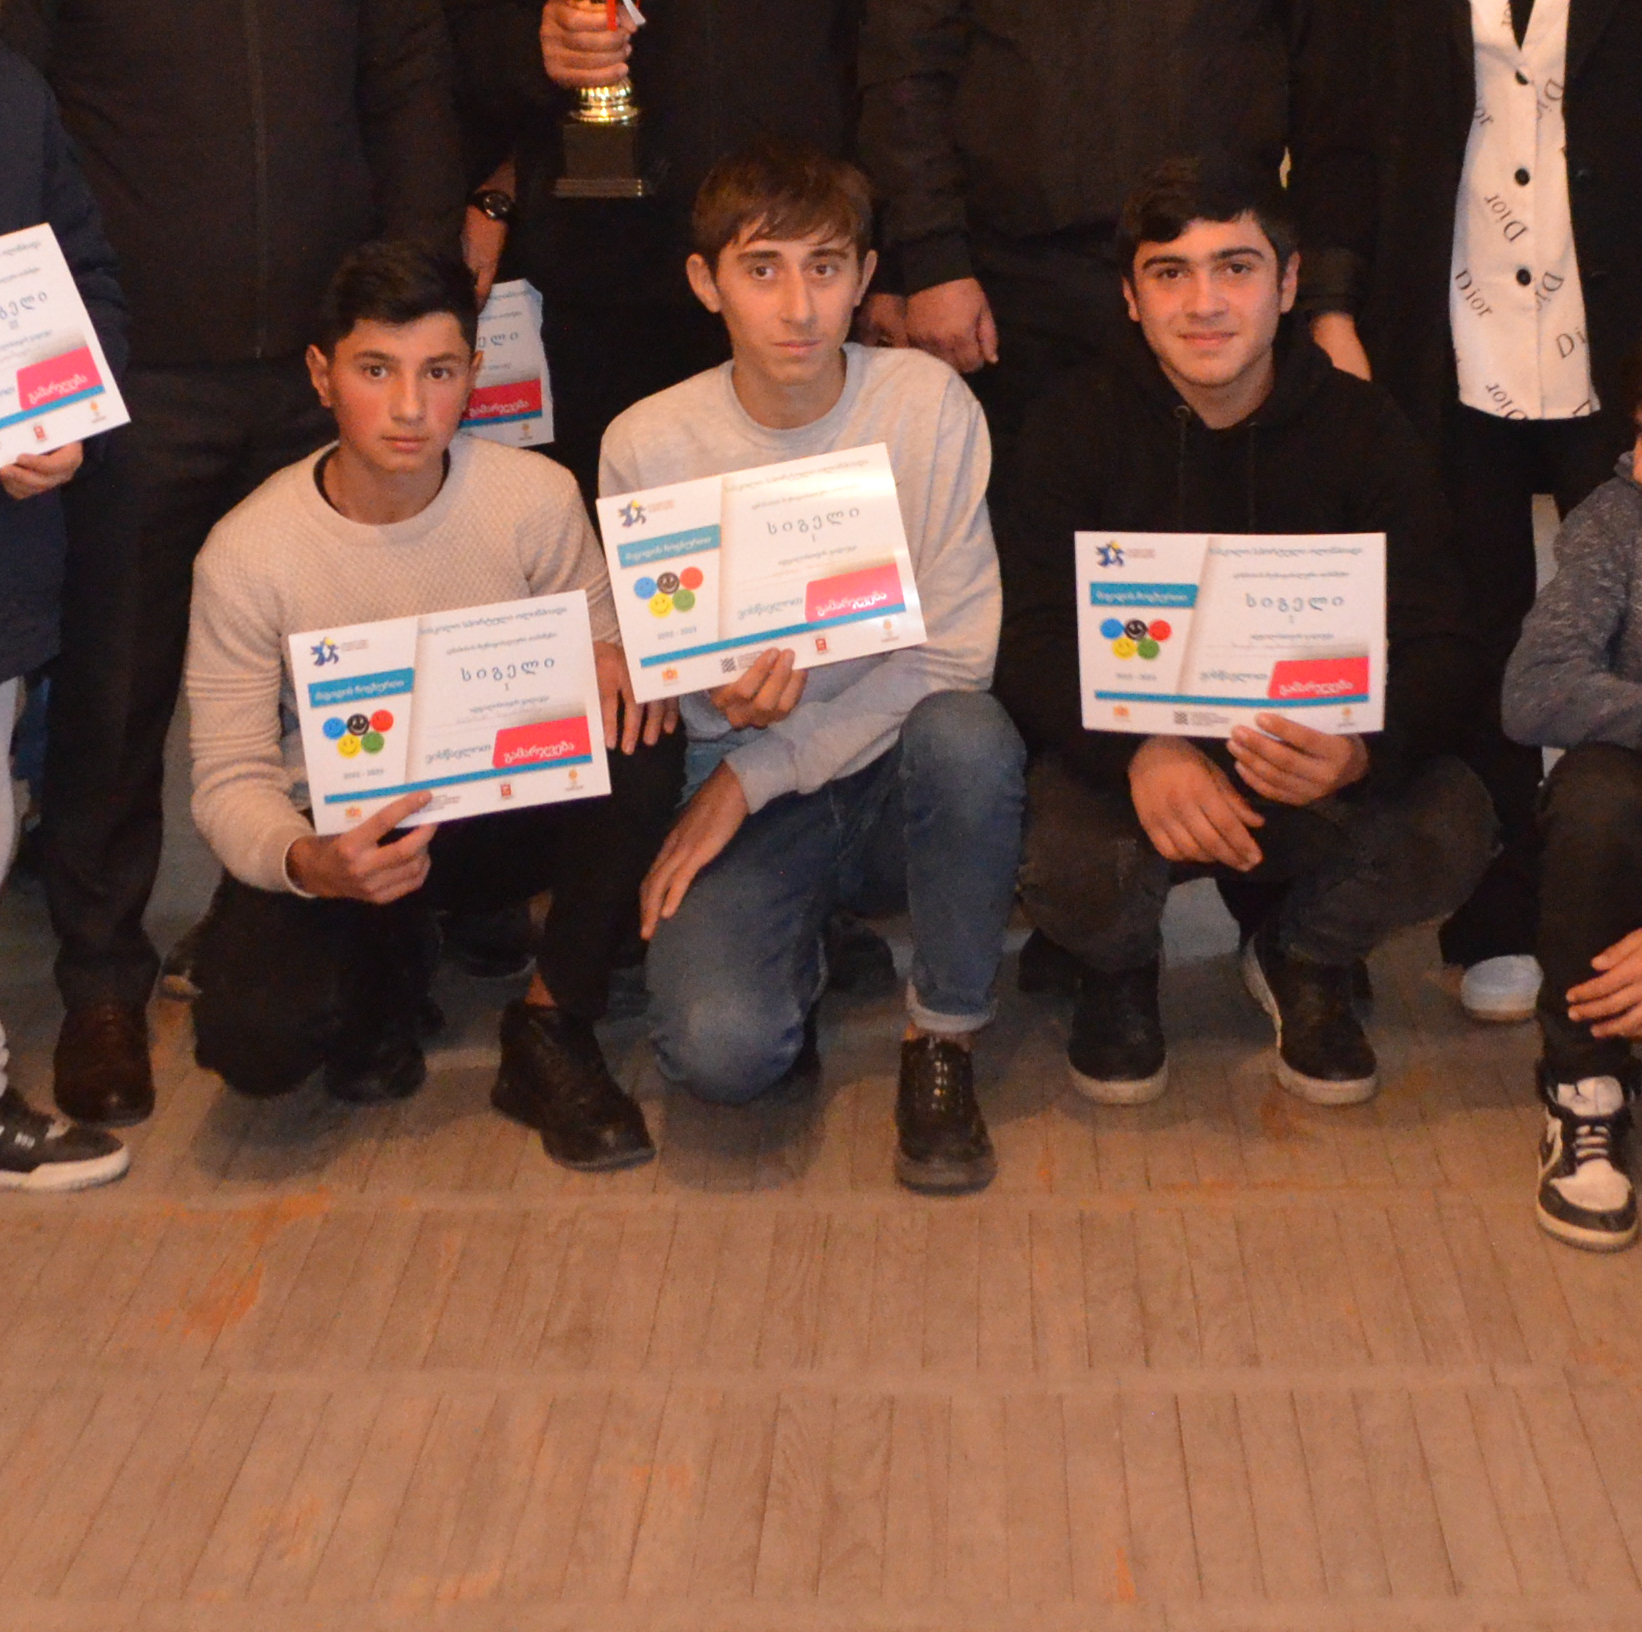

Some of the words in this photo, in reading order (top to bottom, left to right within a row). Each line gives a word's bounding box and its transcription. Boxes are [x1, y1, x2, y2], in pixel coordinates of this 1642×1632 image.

[1484, 194, 1528, 242] Dior
[1455, 270, 1493, 318] Dior
[1535, 271, 1565, 312] Di
[1556, 326, 1587, 360] Di
[766, 506, 860, 535] სიგელი
[1244, 592, 1344, 612] სიგელი
[460, 657, 556, 682] სიგელი
[503, 740, 575, 763] გამარჯვება
